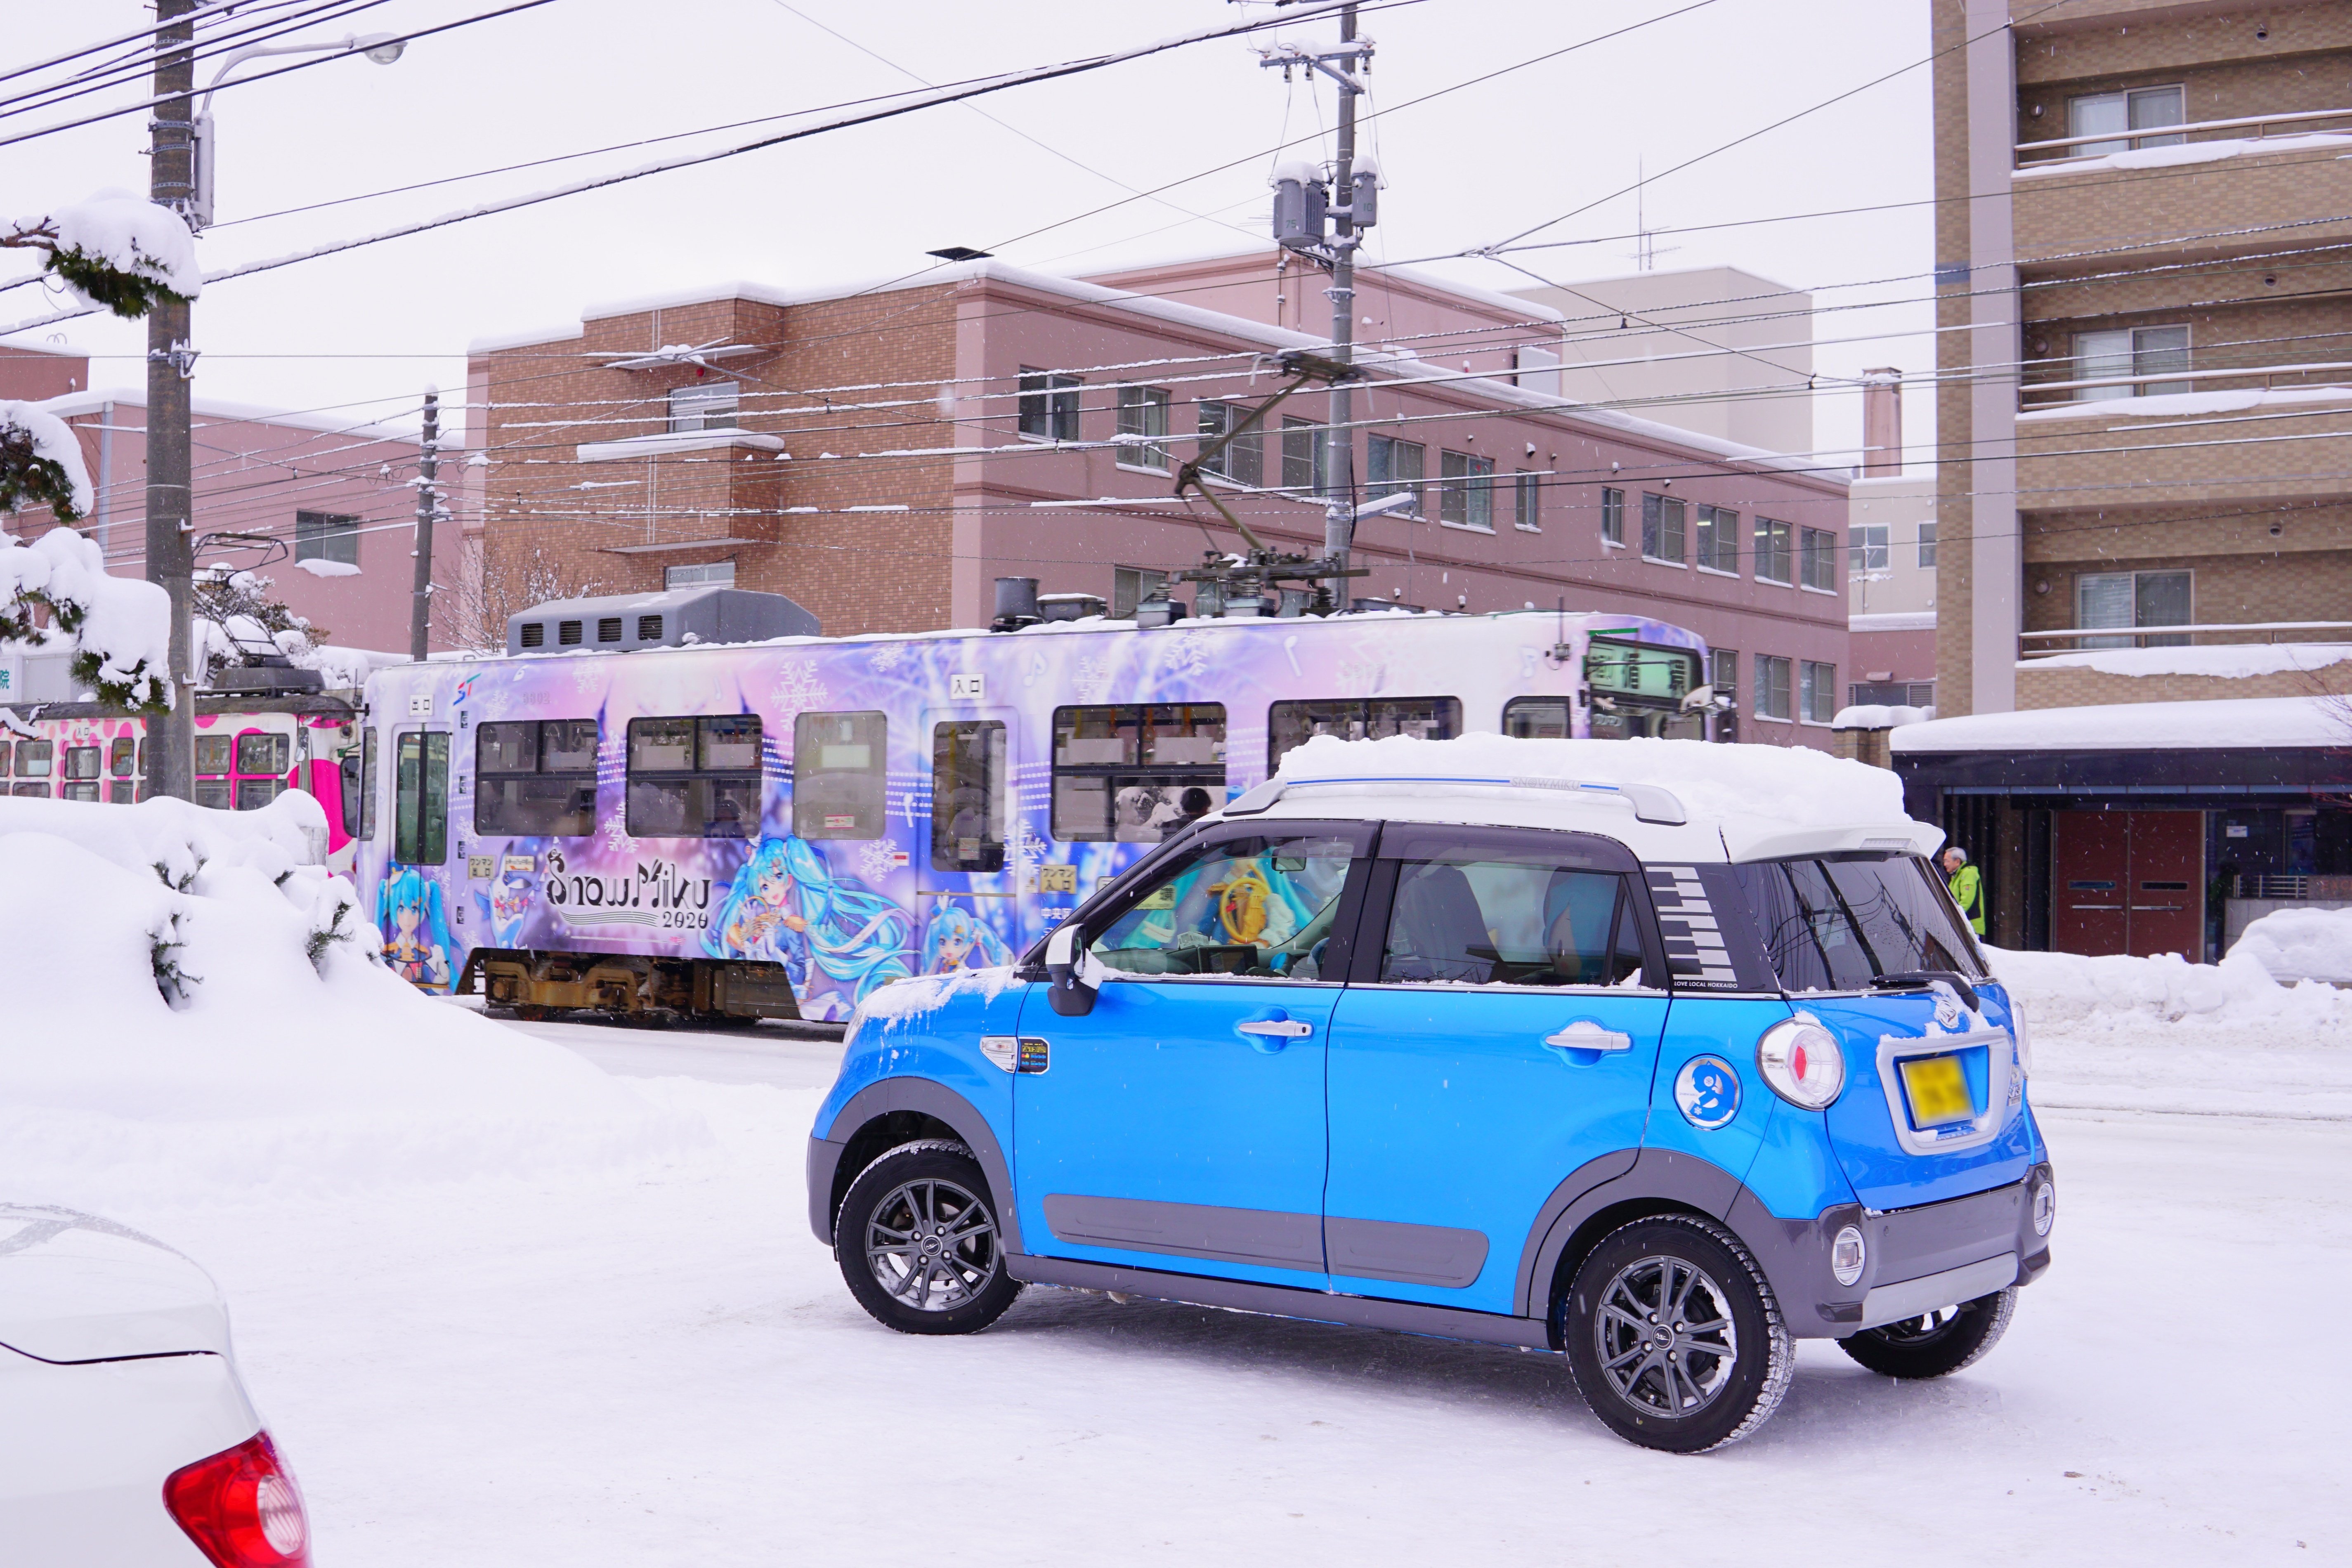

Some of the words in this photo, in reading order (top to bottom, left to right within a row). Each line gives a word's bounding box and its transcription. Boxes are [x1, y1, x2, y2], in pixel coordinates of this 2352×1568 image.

[1363, 203, 1373, 212] 10
[1286, 220, 1297, 229] 75
[954, 679, 980, 694] 入口
[412, 699, 430, 711] 出口
[77, 727, 89, 737] 入口
[472, 868, 491, 876] 出口
[1042, 869, 1074, 877] ワンマン
[1046, 880, 1071, 890] 入口
[662, 911, 708, 929] 2020
